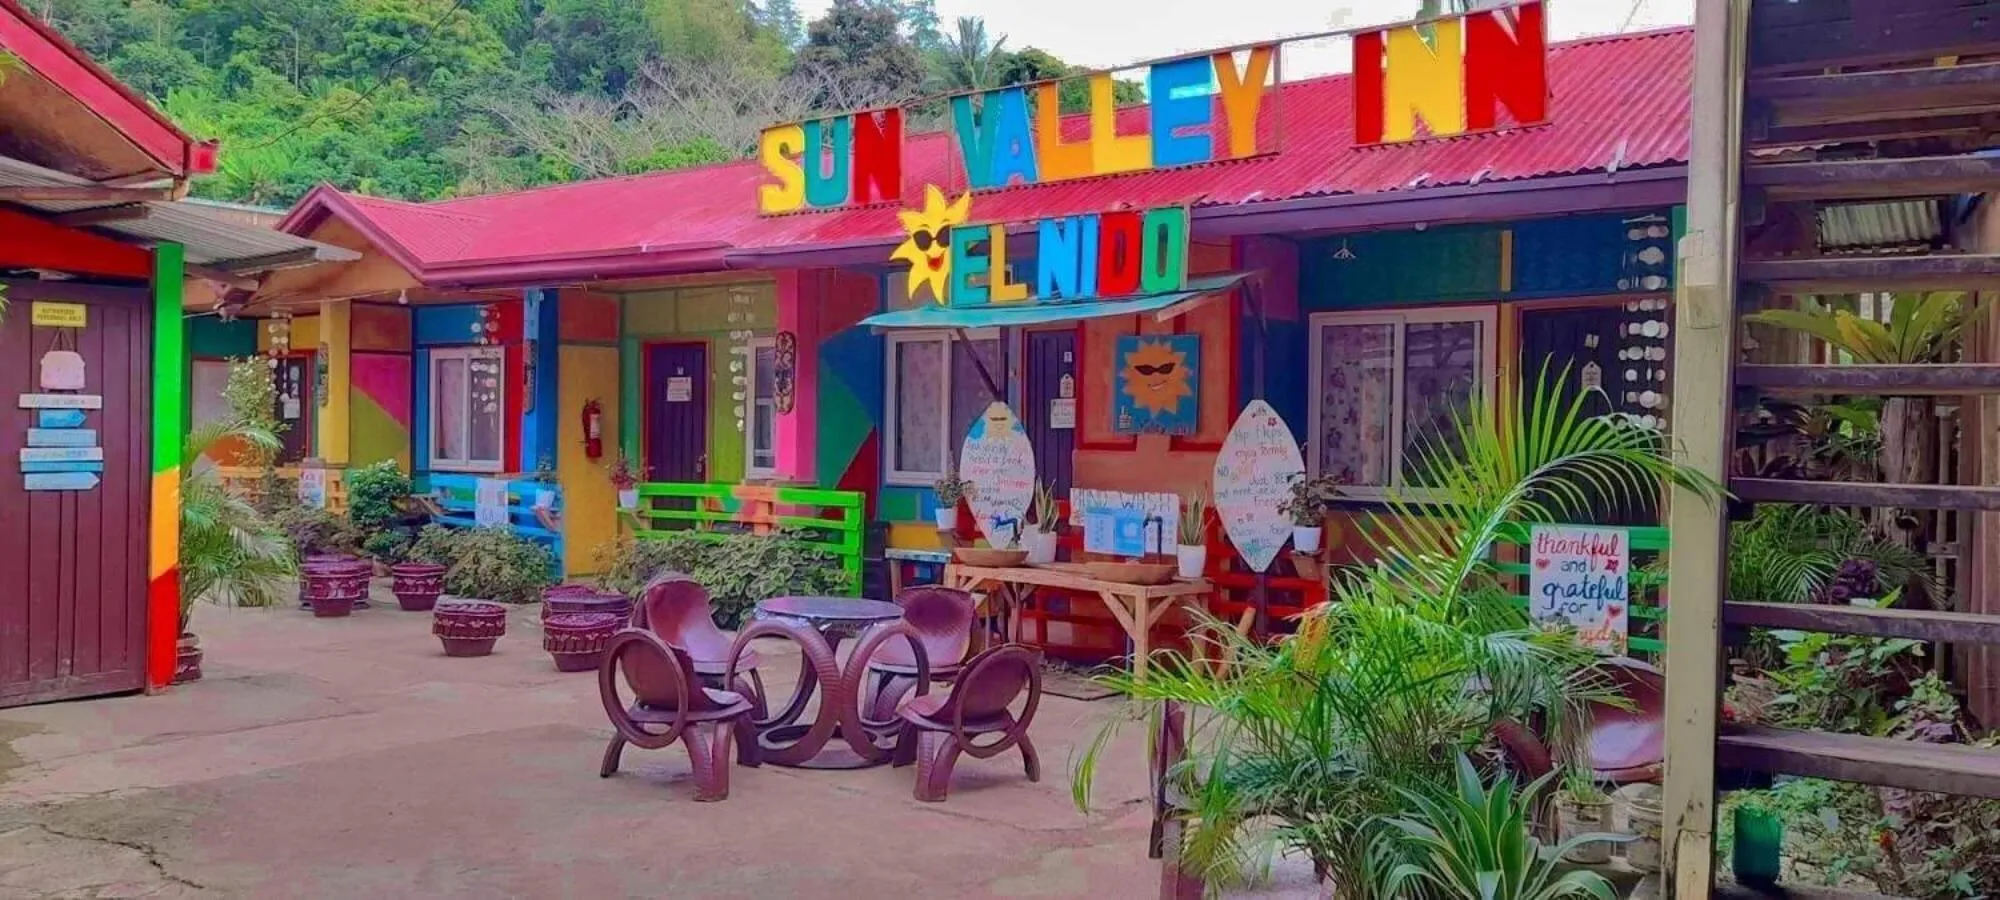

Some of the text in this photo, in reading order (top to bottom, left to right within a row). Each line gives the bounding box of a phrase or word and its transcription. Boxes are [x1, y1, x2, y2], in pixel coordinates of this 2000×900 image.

[760, 1, 1546, 214] SUN VALLEY INN
[951, 206, 1186, 307] EL NIDO
[1537, 532, 1620, 572] thankful
[1561, 558, 1586, 573] and
[1542, 574, 1625, 611] grateful
